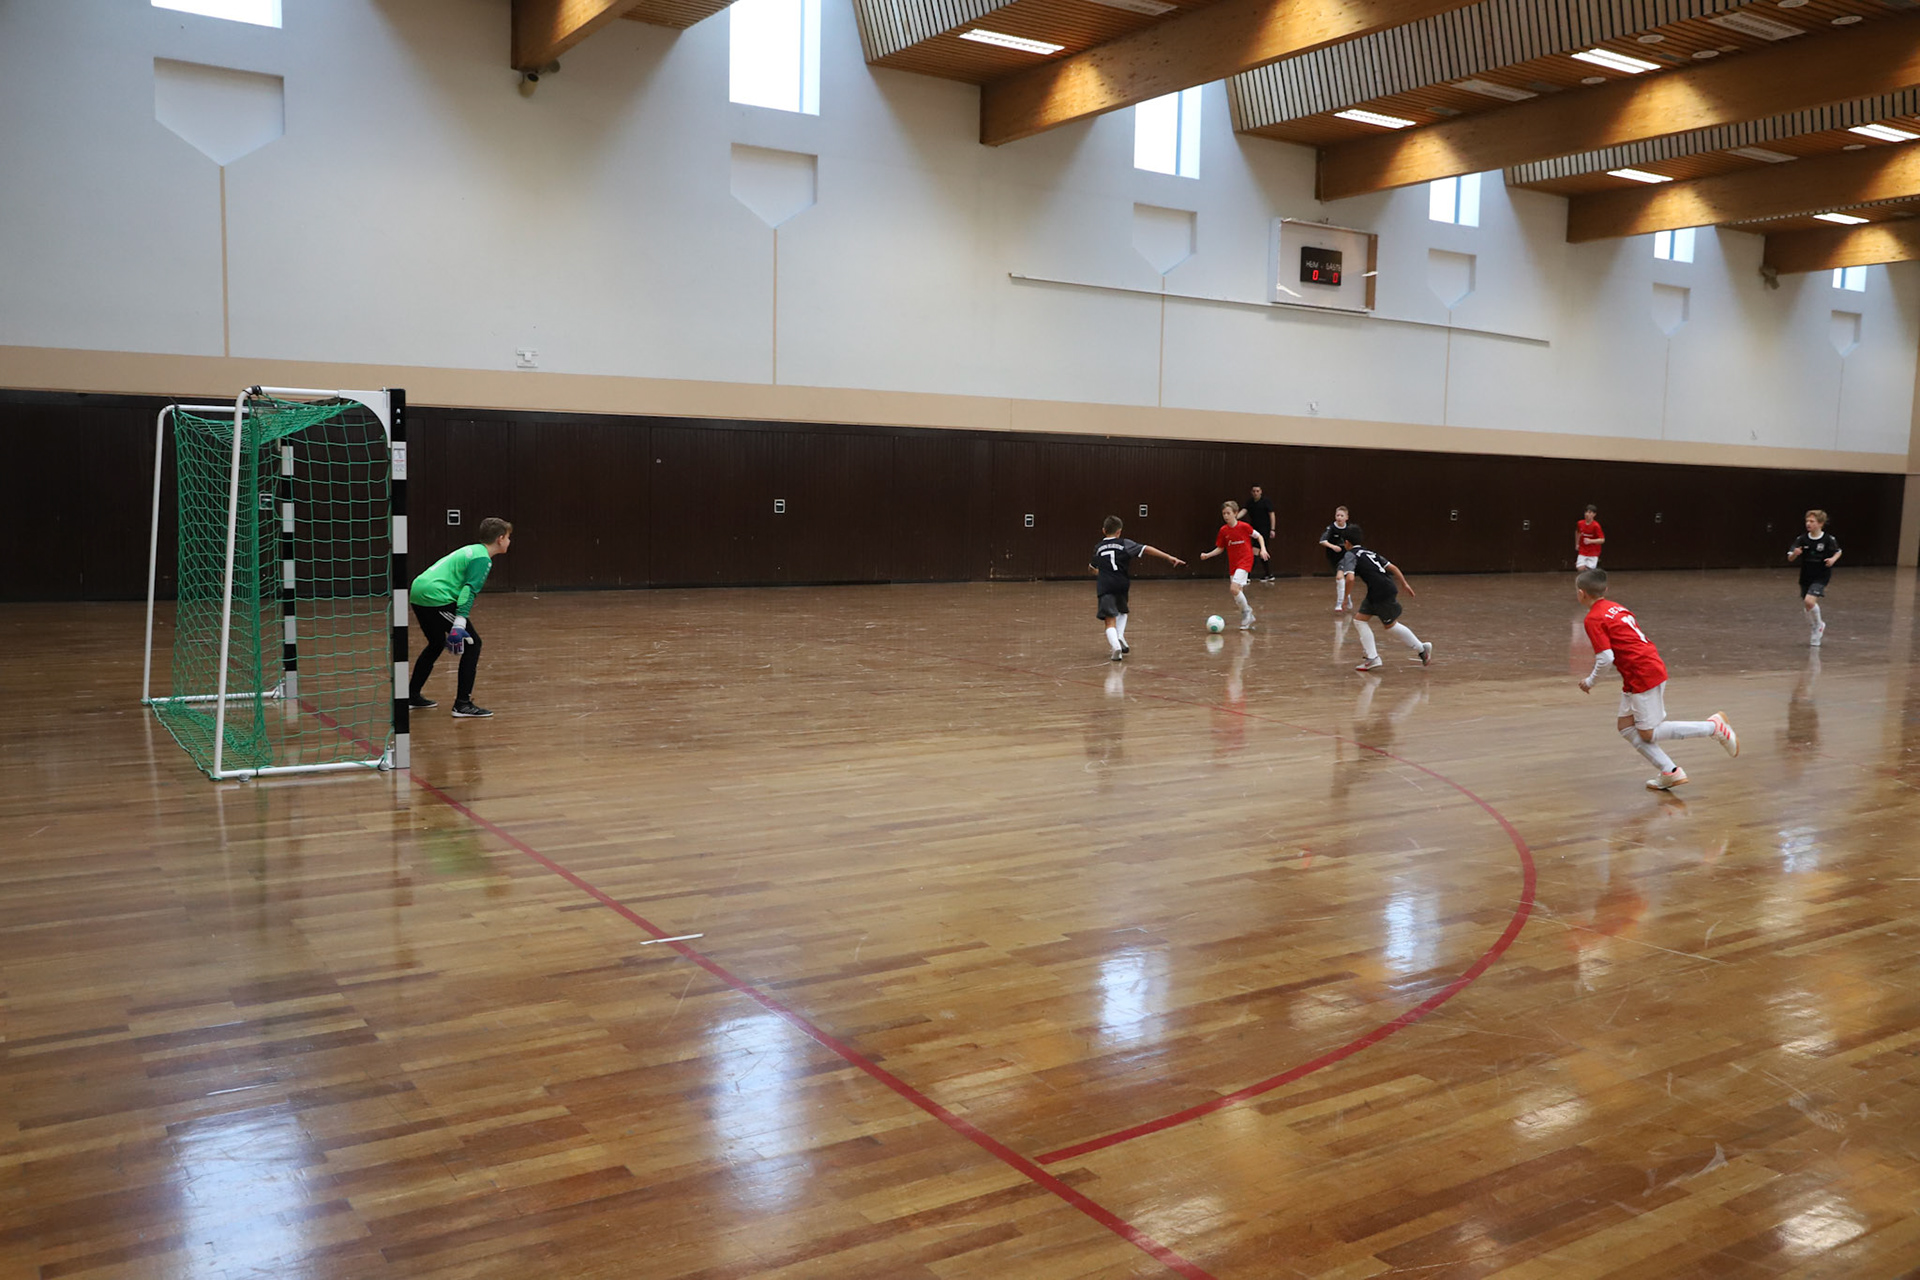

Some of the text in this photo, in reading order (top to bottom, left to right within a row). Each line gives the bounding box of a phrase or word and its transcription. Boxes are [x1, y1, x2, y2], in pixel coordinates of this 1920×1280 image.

[1312, 269, 1339, 283] 0 0
[1101, 551, 1118, 570] 7
